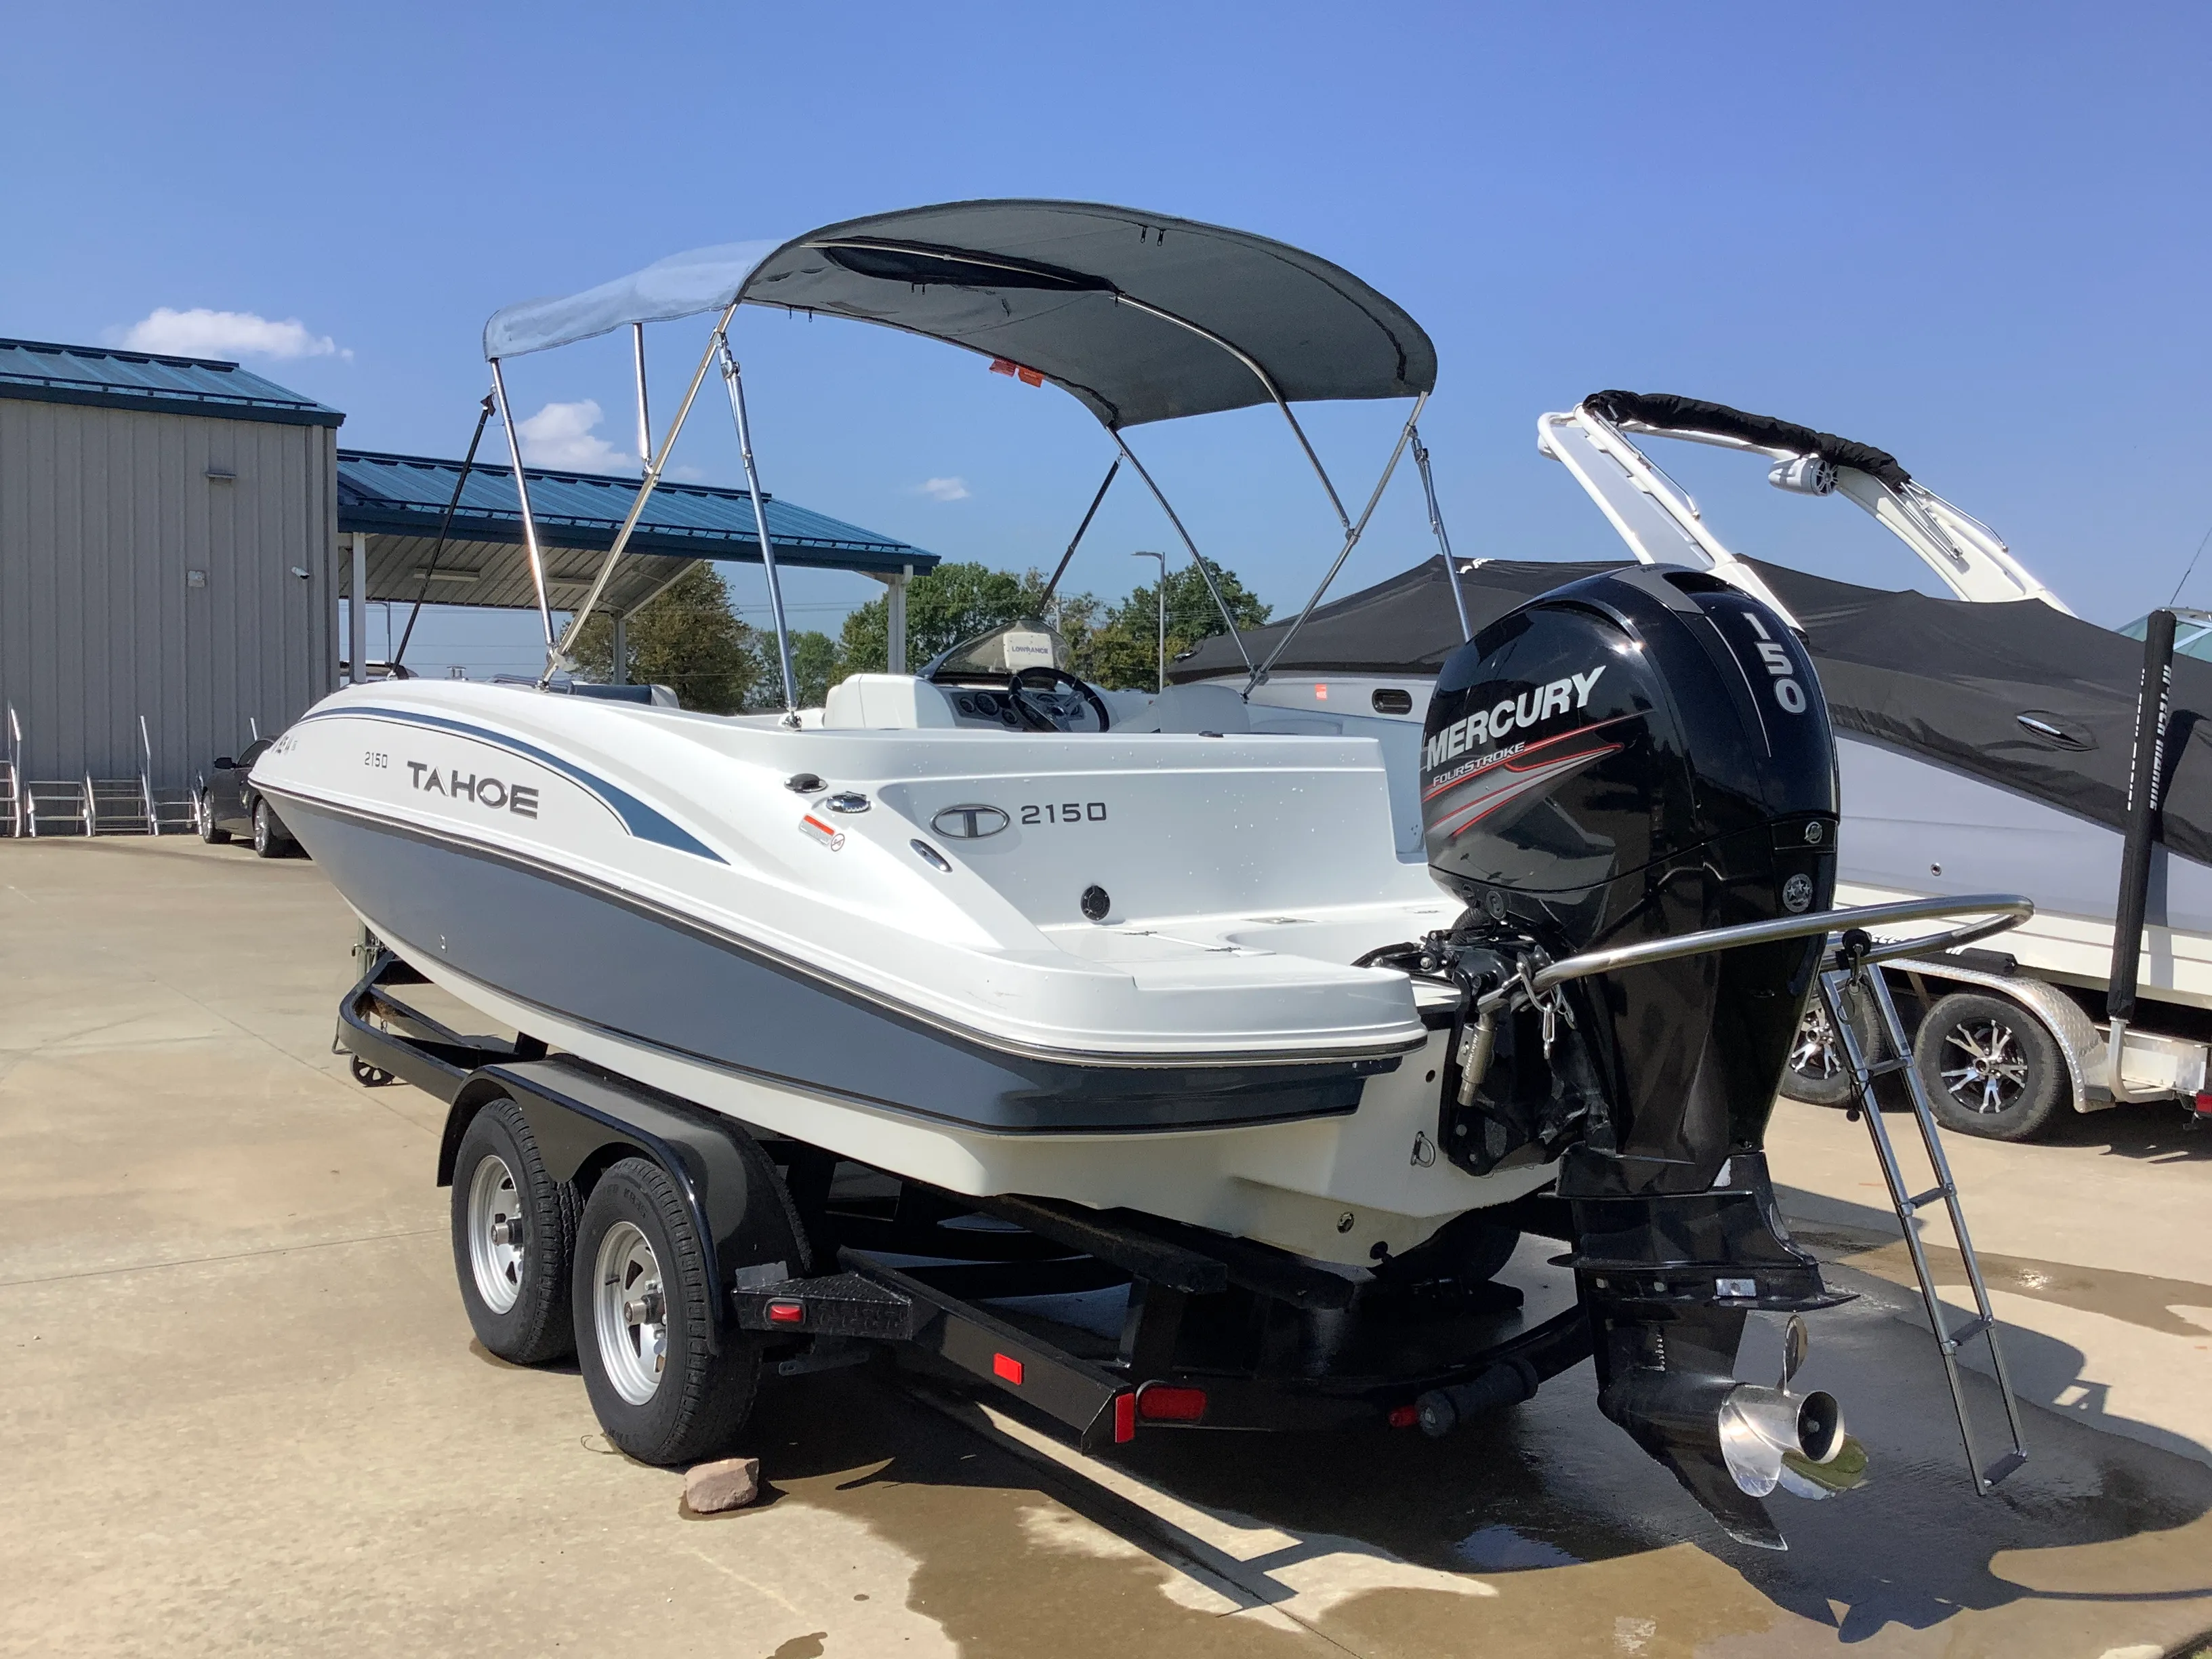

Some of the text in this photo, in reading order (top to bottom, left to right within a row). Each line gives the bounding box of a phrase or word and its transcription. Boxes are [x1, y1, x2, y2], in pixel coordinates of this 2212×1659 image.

[1011, 646, 1049, 655] LOWRANCE
[1742, 612, 1807, 714] 150
[1426, 665, 1607, 773] MERCURY
[364, 751, 388, 769] 2150
[1432, 742, 1526, 788] FOURSTROKE
[407, 760, 539, 819] TAHOE
[1021, 802, 1107, 825] 2150
